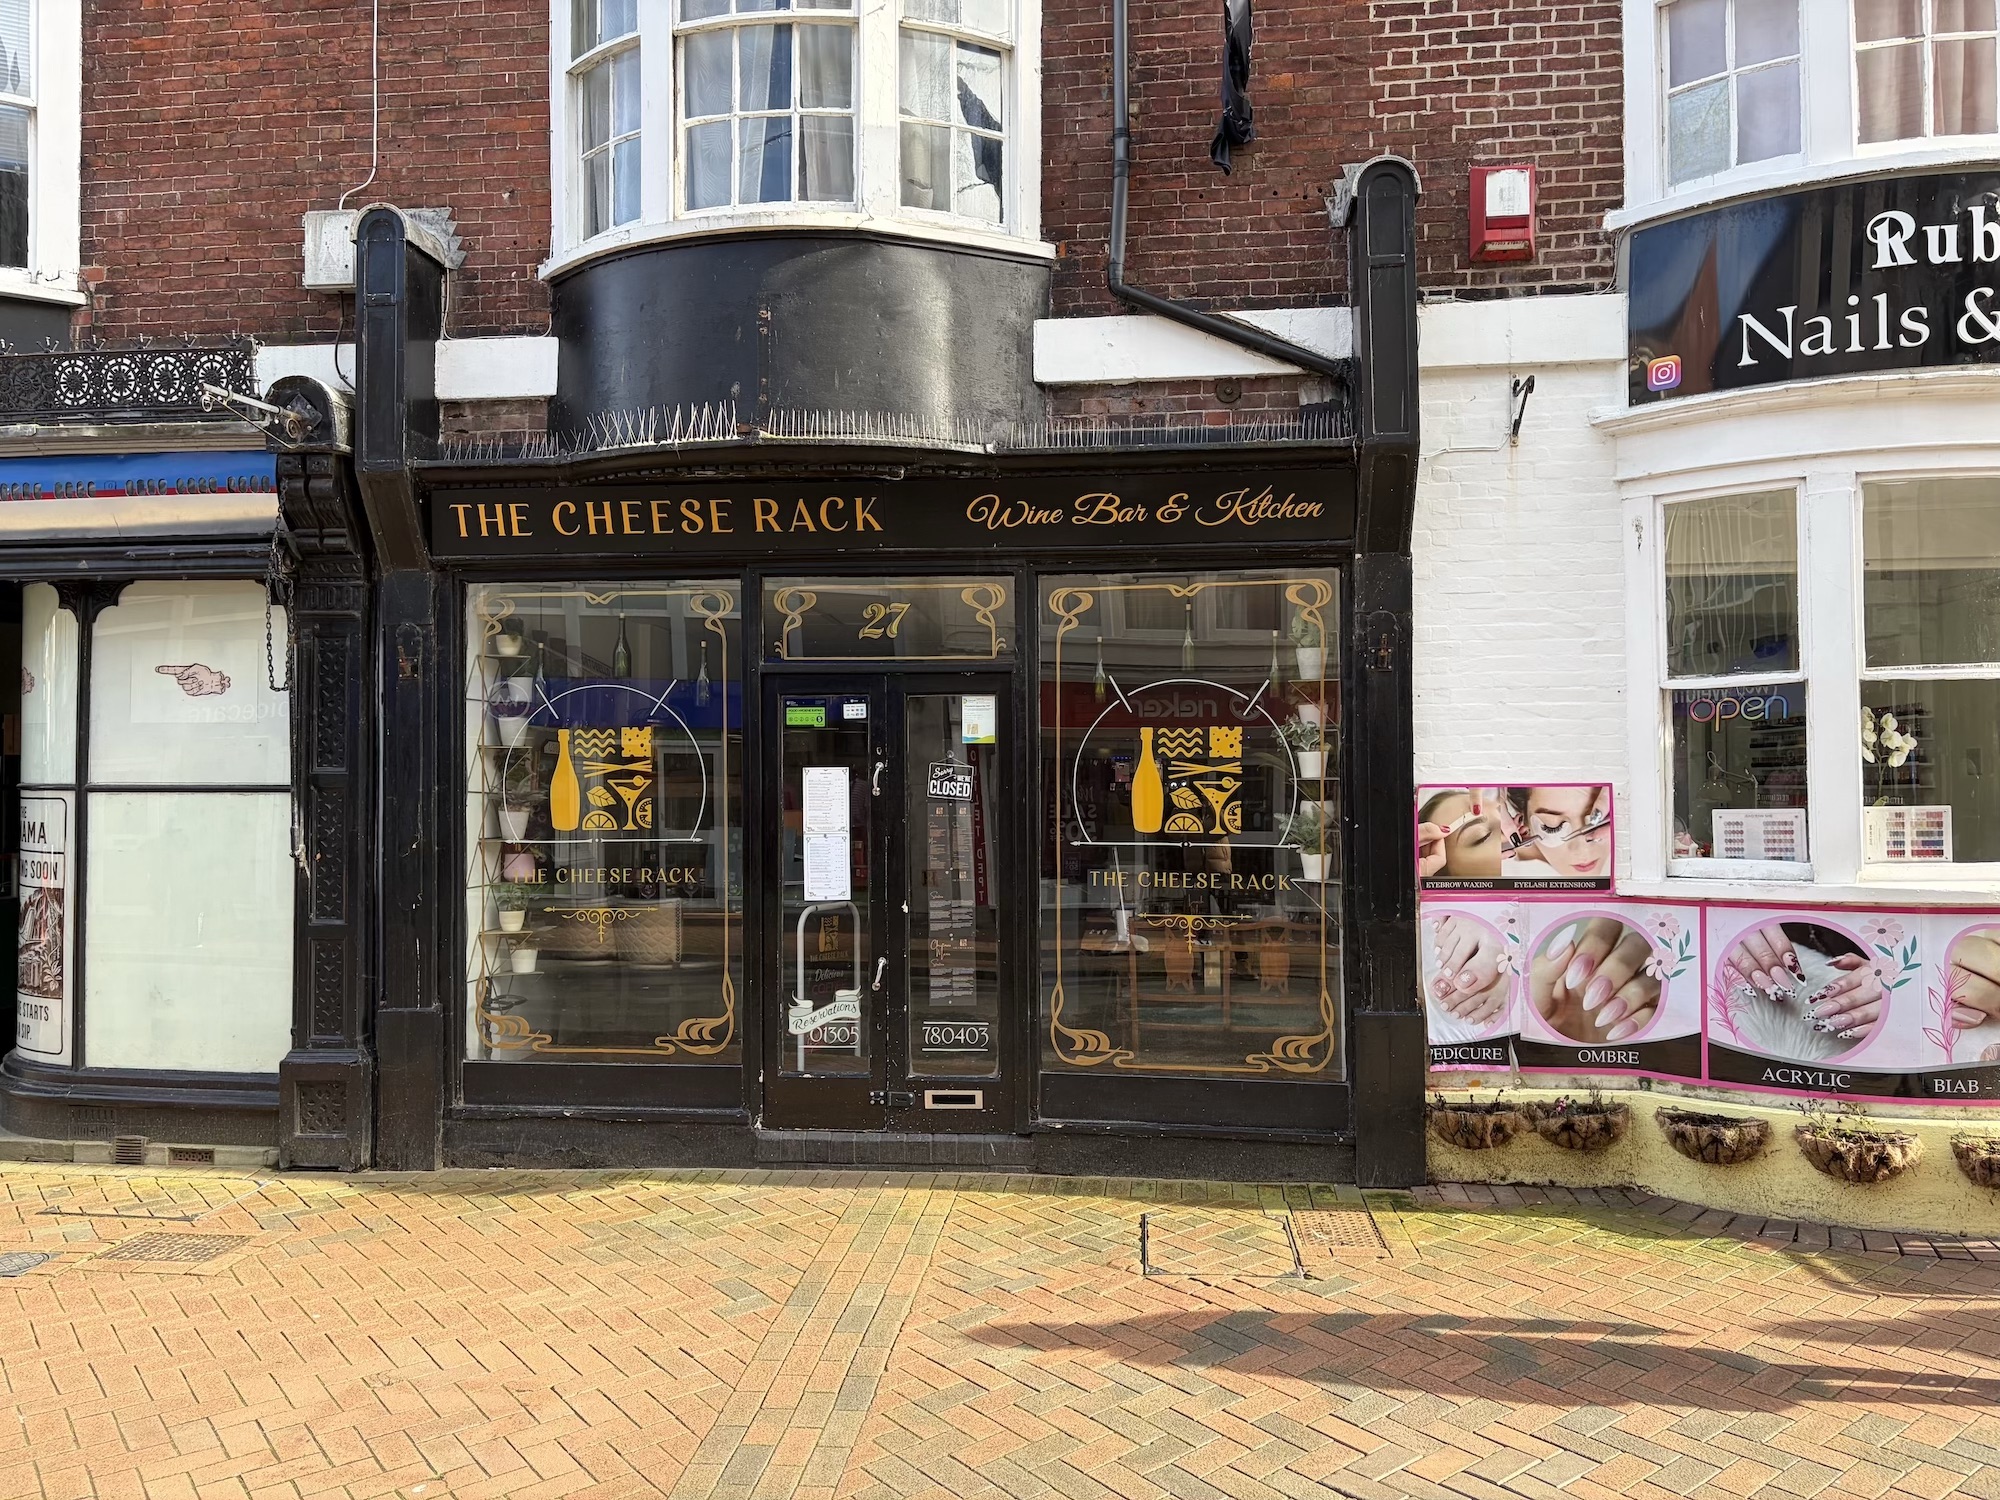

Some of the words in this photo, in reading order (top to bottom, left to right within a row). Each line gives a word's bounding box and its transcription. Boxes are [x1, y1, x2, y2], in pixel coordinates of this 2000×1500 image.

[1737, 291, 1931, 367] Nails
[1956, 286, 2000, 344] &
[449, 503, 533, 538] THE
[552, 498, 735, 536] CHEESE
[754, 496, 884, 532] RACK
[966, 494, 1064, 530] Wine
[1071, 493, 1148, 525] Bar
[1156, 493, 1190, 523] &
[1195, 485, 1325, 526] Kitchen
[859, 602, 911, 640] 27
[1689, 695, 1788, 732] open
[930, 780, 970, 797] CLOSED
[30, 860, 58, 880] SOON
[512, 868, 547, 884] THE
[556, 868, 633, 884] CHEESE
[641, 868, 697, 884] RACK
[1089, 871, 1129, 888] THE
[1137, 871, 1222, 889] CHEESE
[1230, 873, 1291, 891] RACK
[23, 1002, 49, 1021] STARTS
[792, 1003, 857, 1030] Reservations
[21, 1023, 32, 1040] SIP.
[809, 1026, 859, 1045] 01305
[923, 1026, 989, 1047] 780403
[1578, 1049, 1640, 1064] OMBRE
[1761, 1067, 1851, 1088] ACRYLIC
[1933, 1078, 1979, 1094] BIAB
